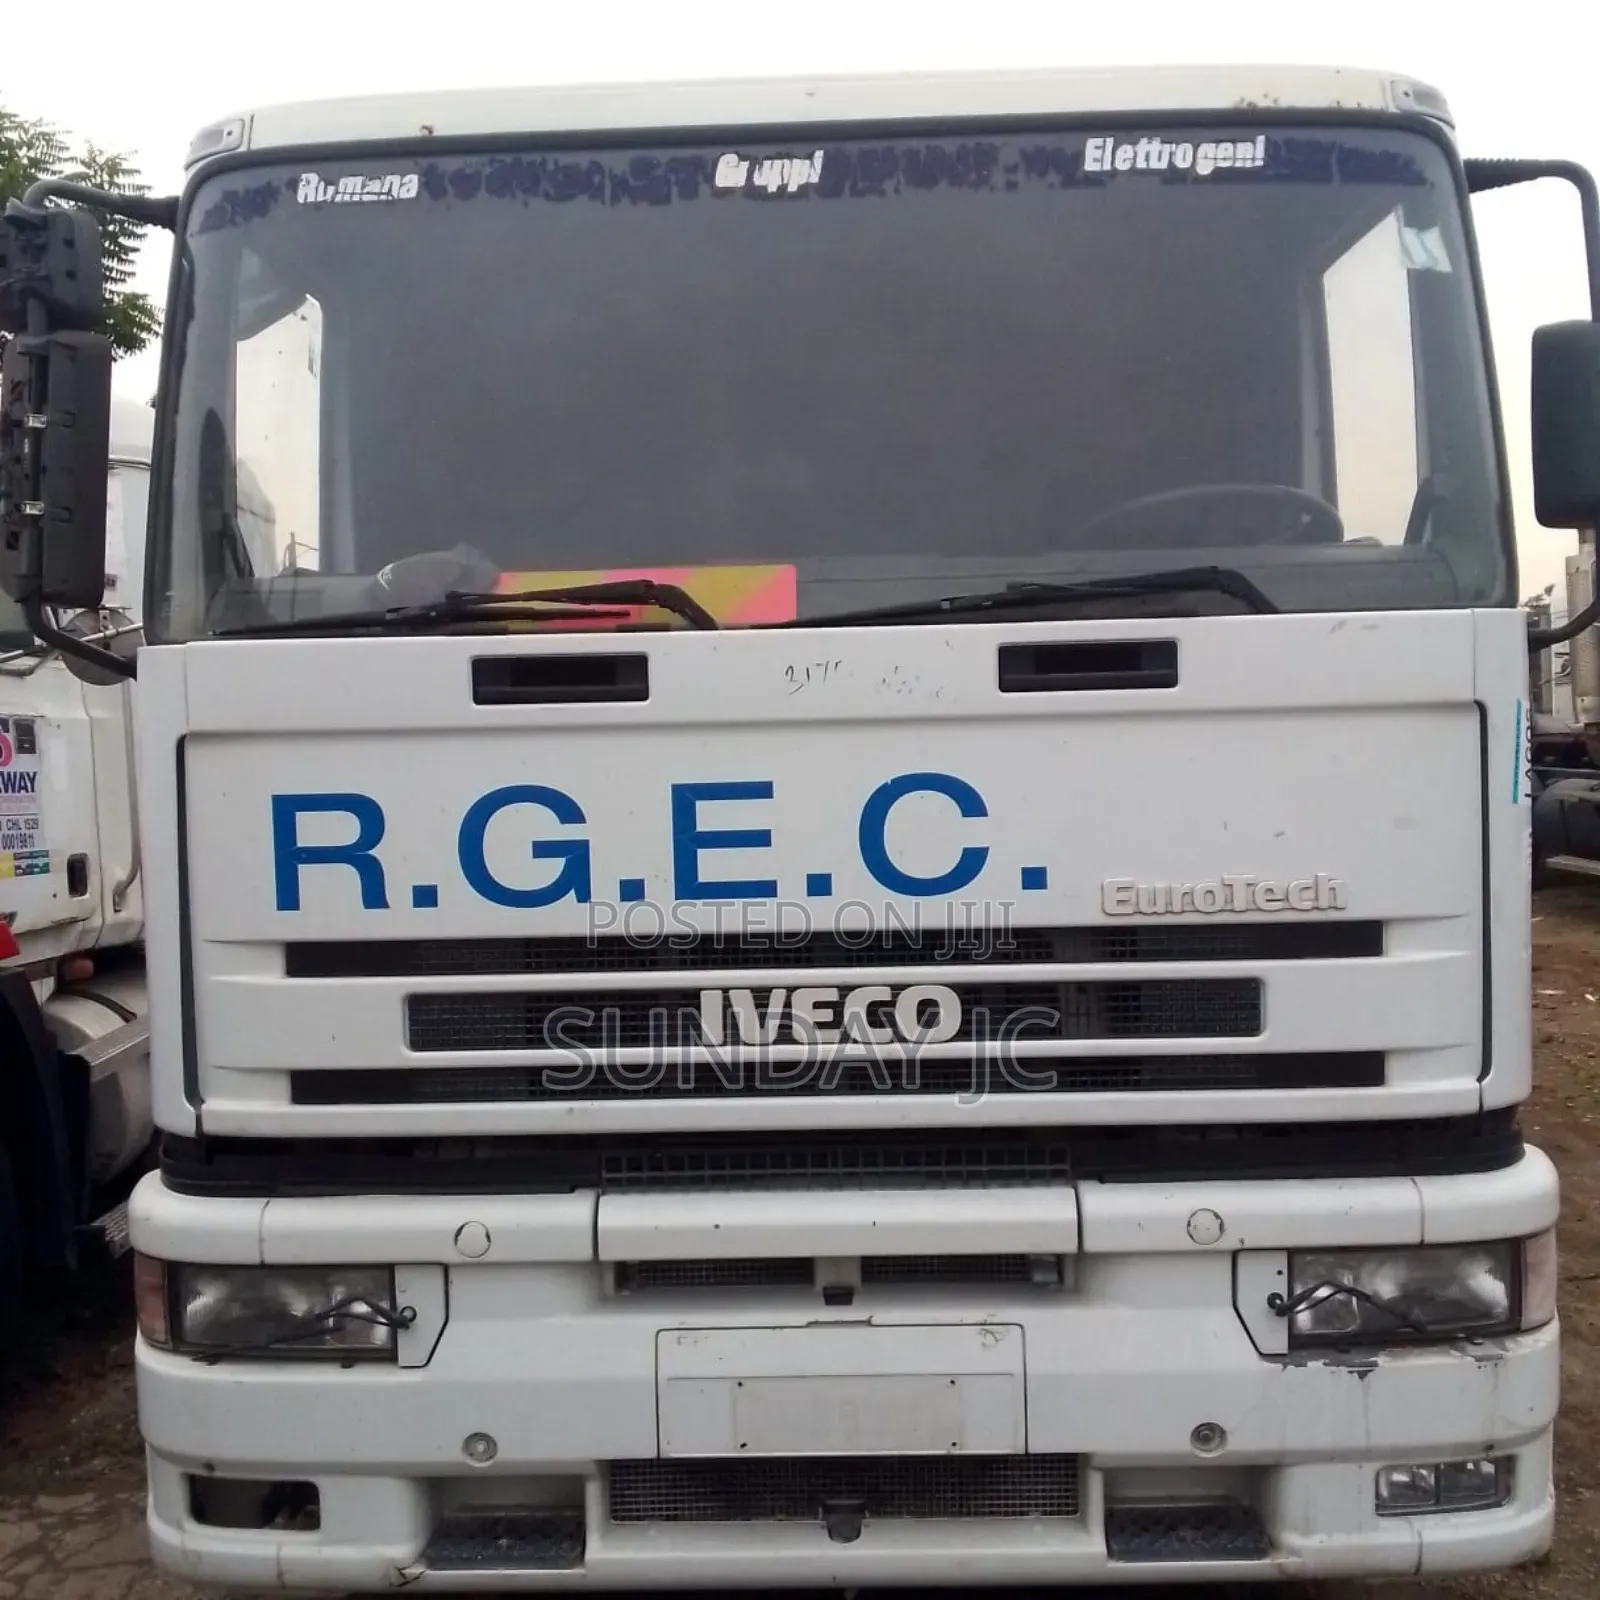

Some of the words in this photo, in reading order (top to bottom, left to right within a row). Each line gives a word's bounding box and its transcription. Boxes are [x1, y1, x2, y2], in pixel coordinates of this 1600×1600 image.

[0, 771, 38, 793] WAY
[271, 771, 1048, 912] R.G.E.C.
[1101, 872, 1348, 916] EuroTech
[699, 984, 962, 1046] IVECO
